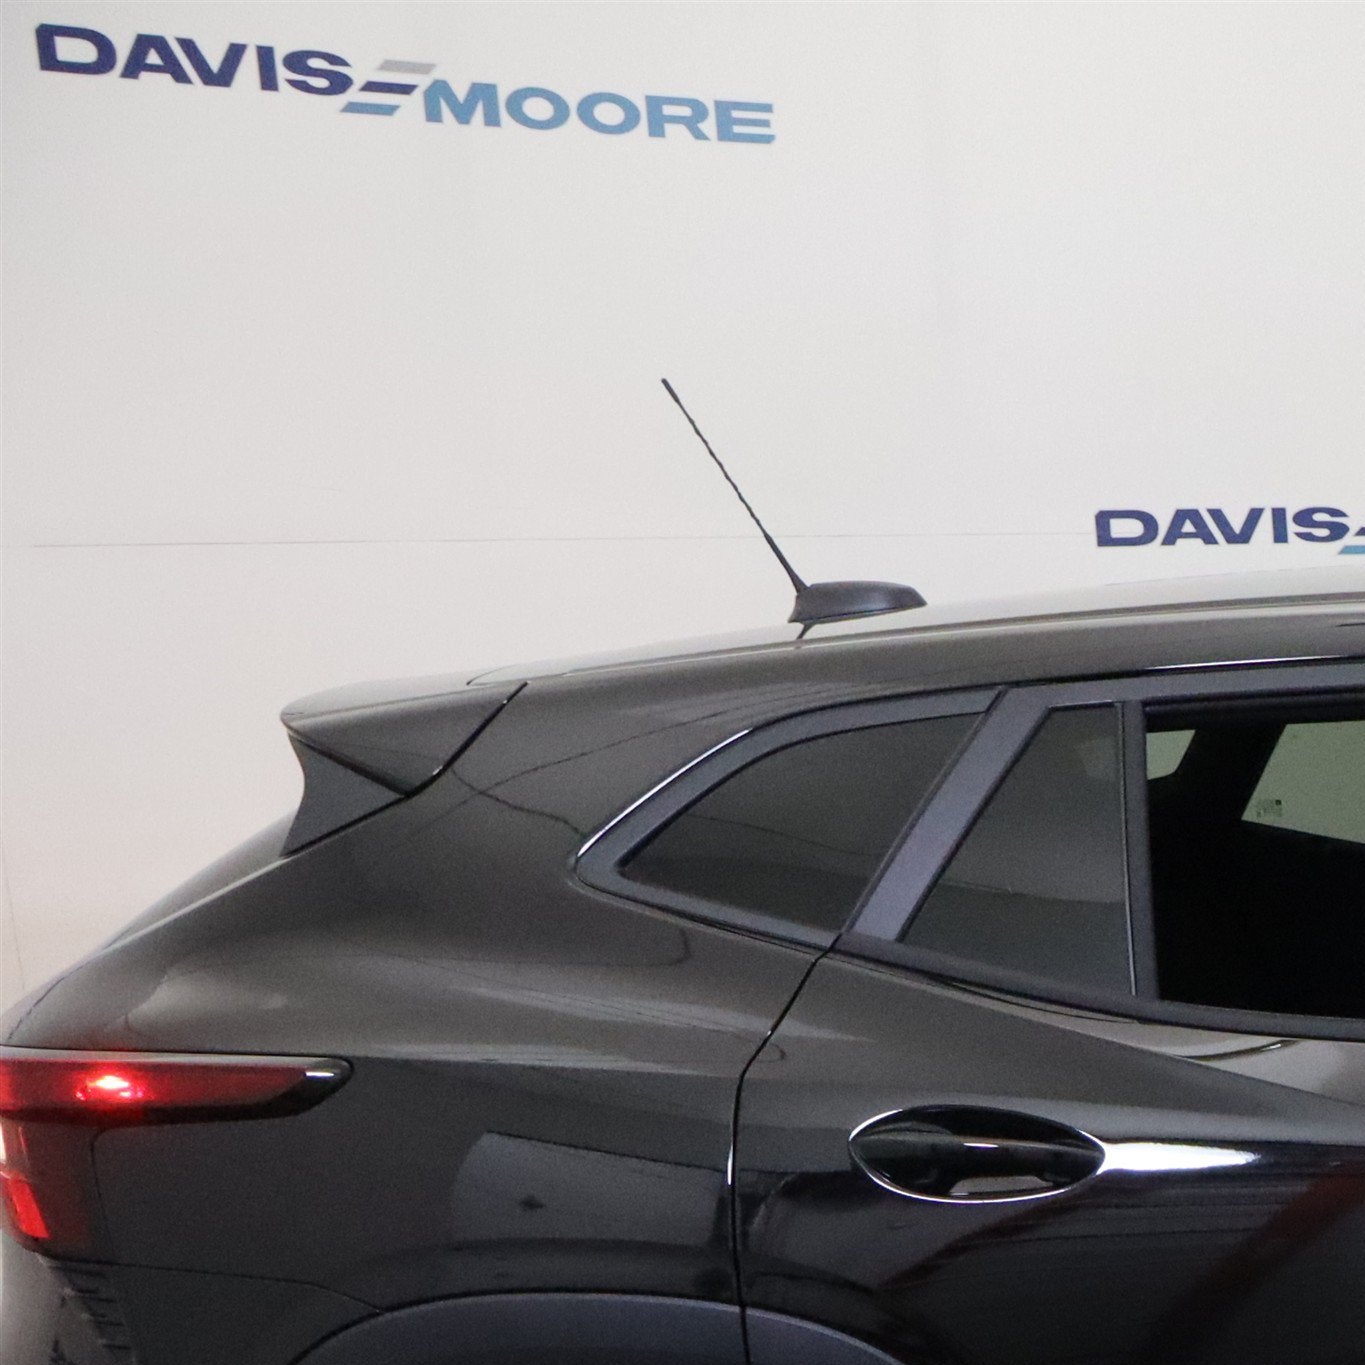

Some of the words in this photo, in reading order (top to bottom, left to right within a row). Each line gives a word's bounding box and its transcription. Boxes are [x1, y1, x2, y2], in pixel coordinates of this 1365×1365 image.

[35, 22, 354, 96] DAVIS
[423, 79, 776, 144] MOORE
[1094, 506, 1351, 547] DAVIS
